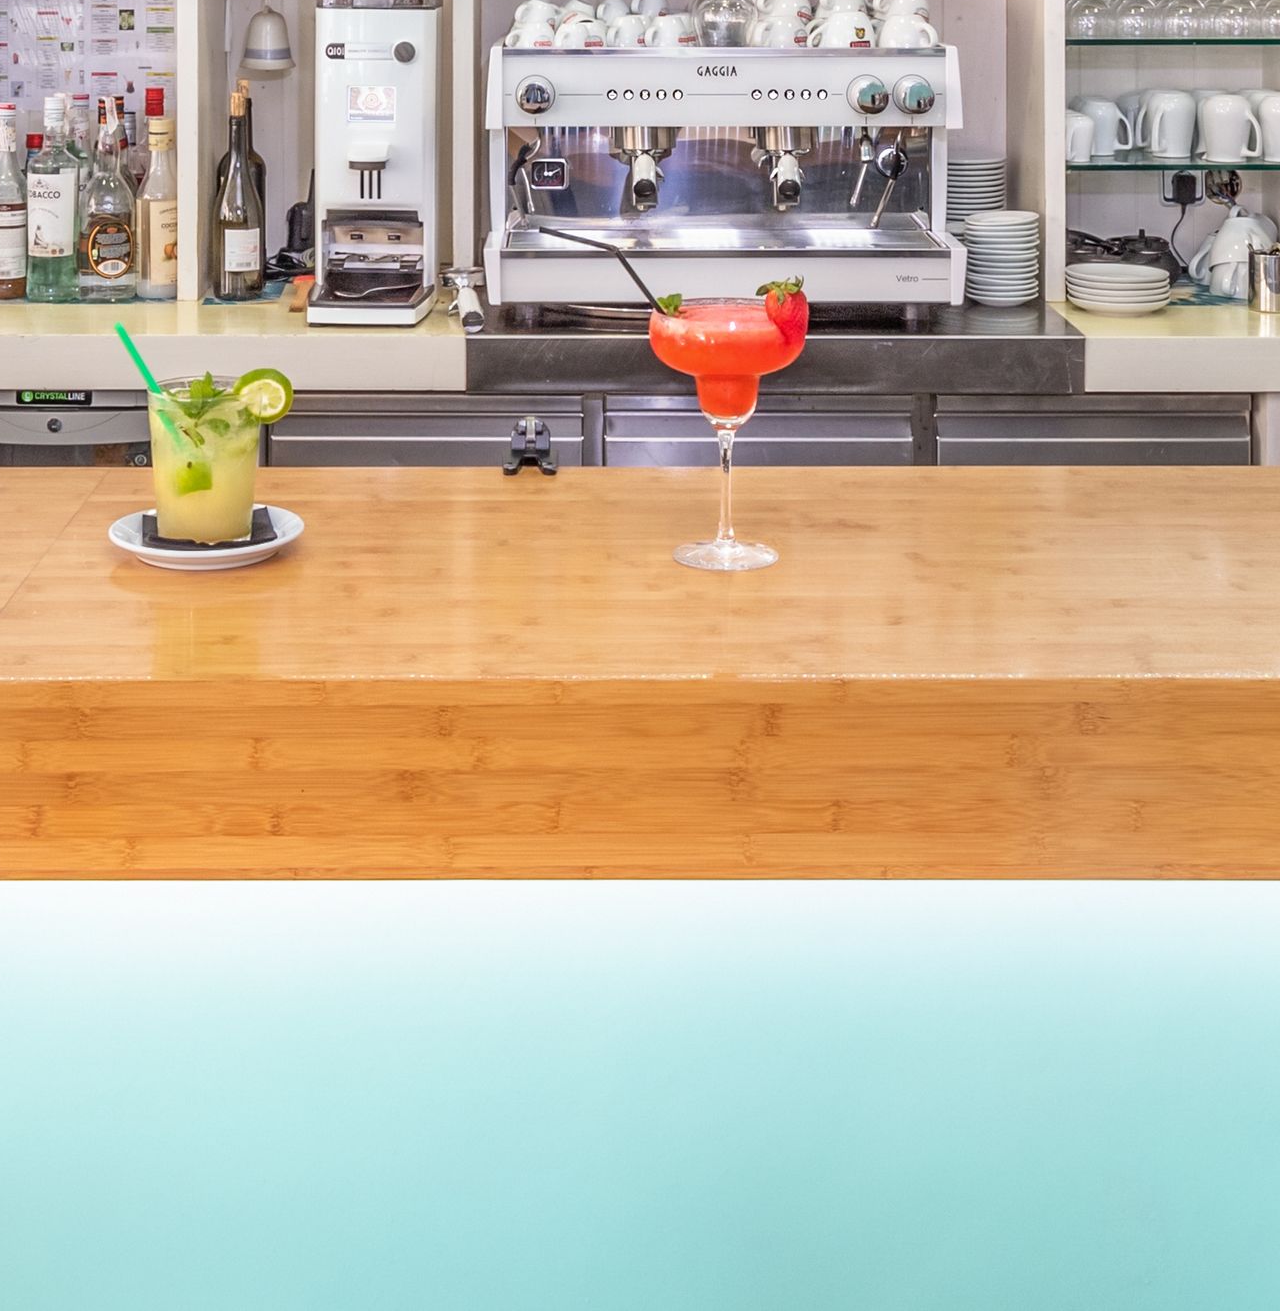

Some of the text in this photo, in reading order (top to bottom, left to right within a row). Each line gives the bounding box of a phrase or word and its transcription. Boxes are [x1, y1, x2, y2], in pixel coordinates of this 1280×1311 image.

[696, 65, 738, 77] GAGGIA
[895, 273, 919, 282] Vetro
[34, 392, 86, 401] CRYSTALLINE
